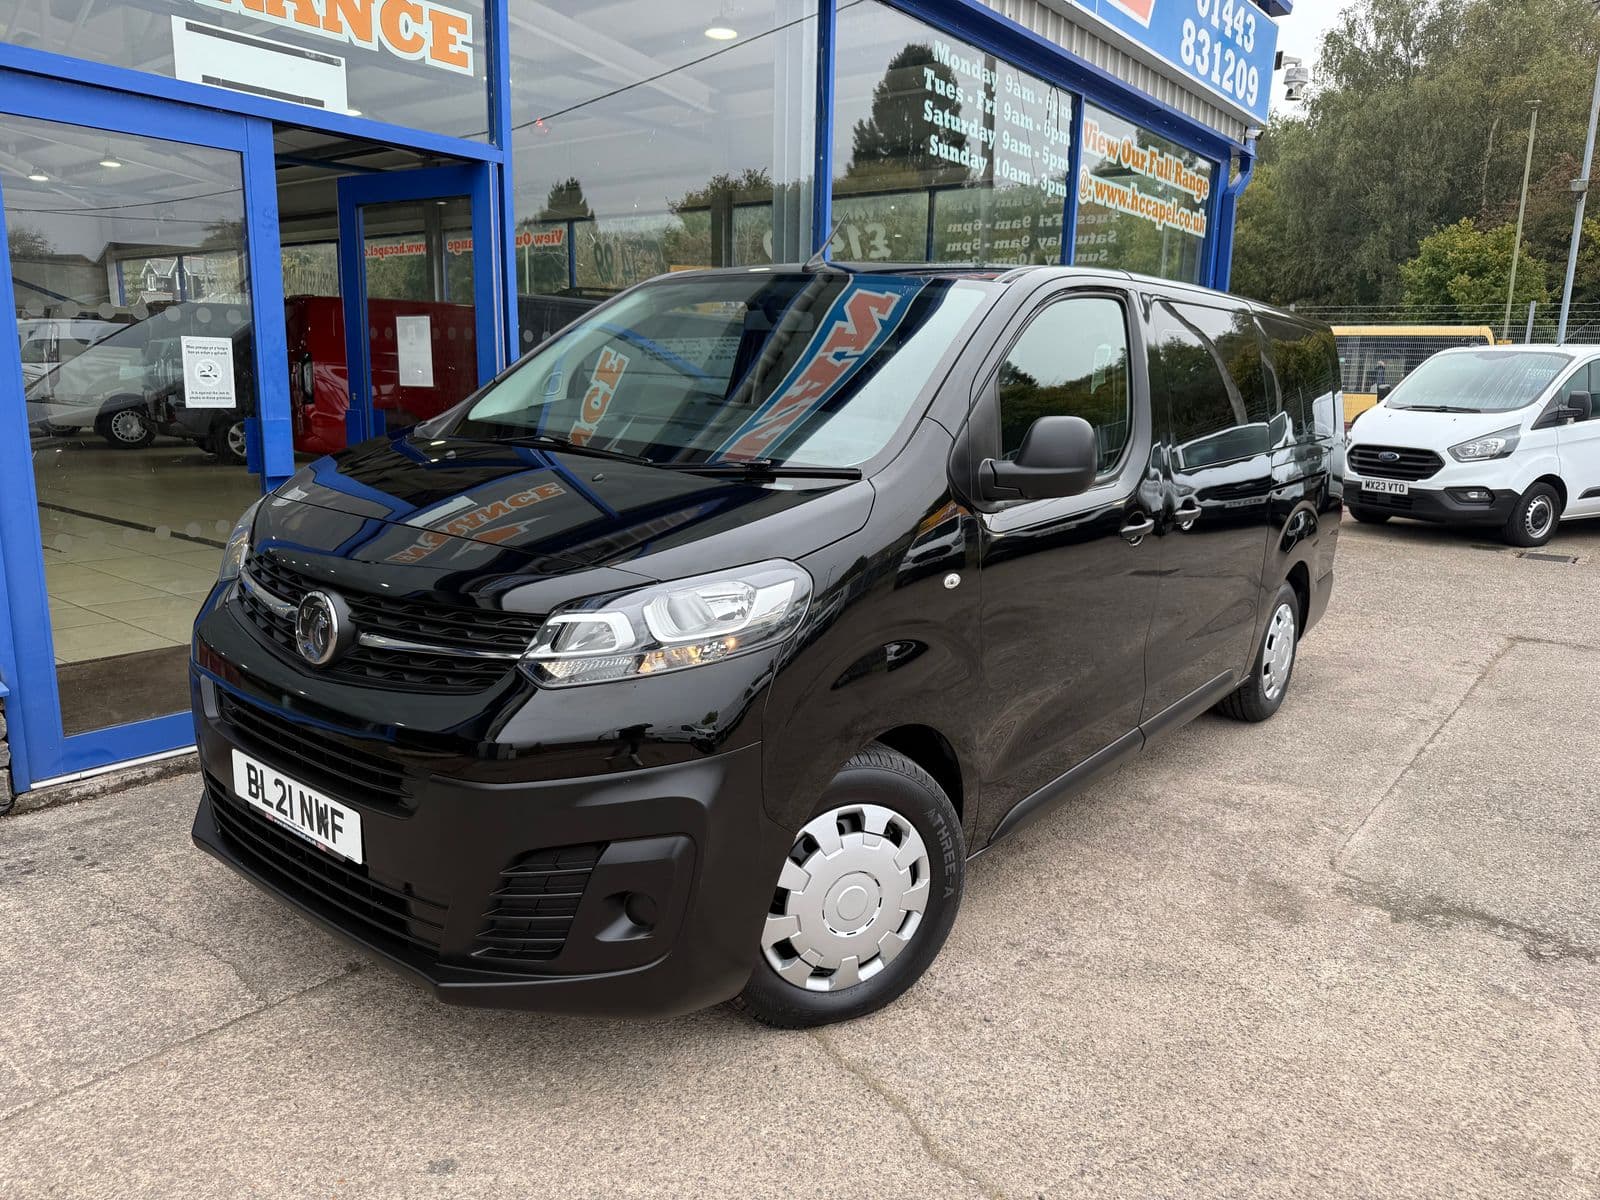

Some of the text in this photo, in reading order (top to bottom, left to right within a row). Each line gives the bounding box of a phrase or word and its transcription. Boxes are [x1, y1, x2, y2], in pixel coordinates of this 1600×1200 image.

[933, 40, 999, 92] Monday
[1005, 73, 1035, 104] 9am
[1180, 18, 1259, 107] 831209
[924, 67, 964, 103] Tues
[976, 90, 997, 116] Fri
[1004, 102, 1033, 131] 9am
[924, 99, 996, 150] Saturday
[1003, 130, 1031, 159] 9am
[1042, 147, 1069, 172] 5pm
[930, 134, 987, 176] Sunday
[995, 158, 1031, 185] 10am
[1040, 173, 1067, 198] 3pm
[1083, 119, 1209, 202] View Our Full Range
[1094, 178, 1206, 237] www.hccapel.co.uk
[1365, 480, 1405, 493] WX23 VTO
[246, 761, 294, 821] BL21
[299, 789, 345, 845] NWF
[934, 813, 956, 899] THREE-A
